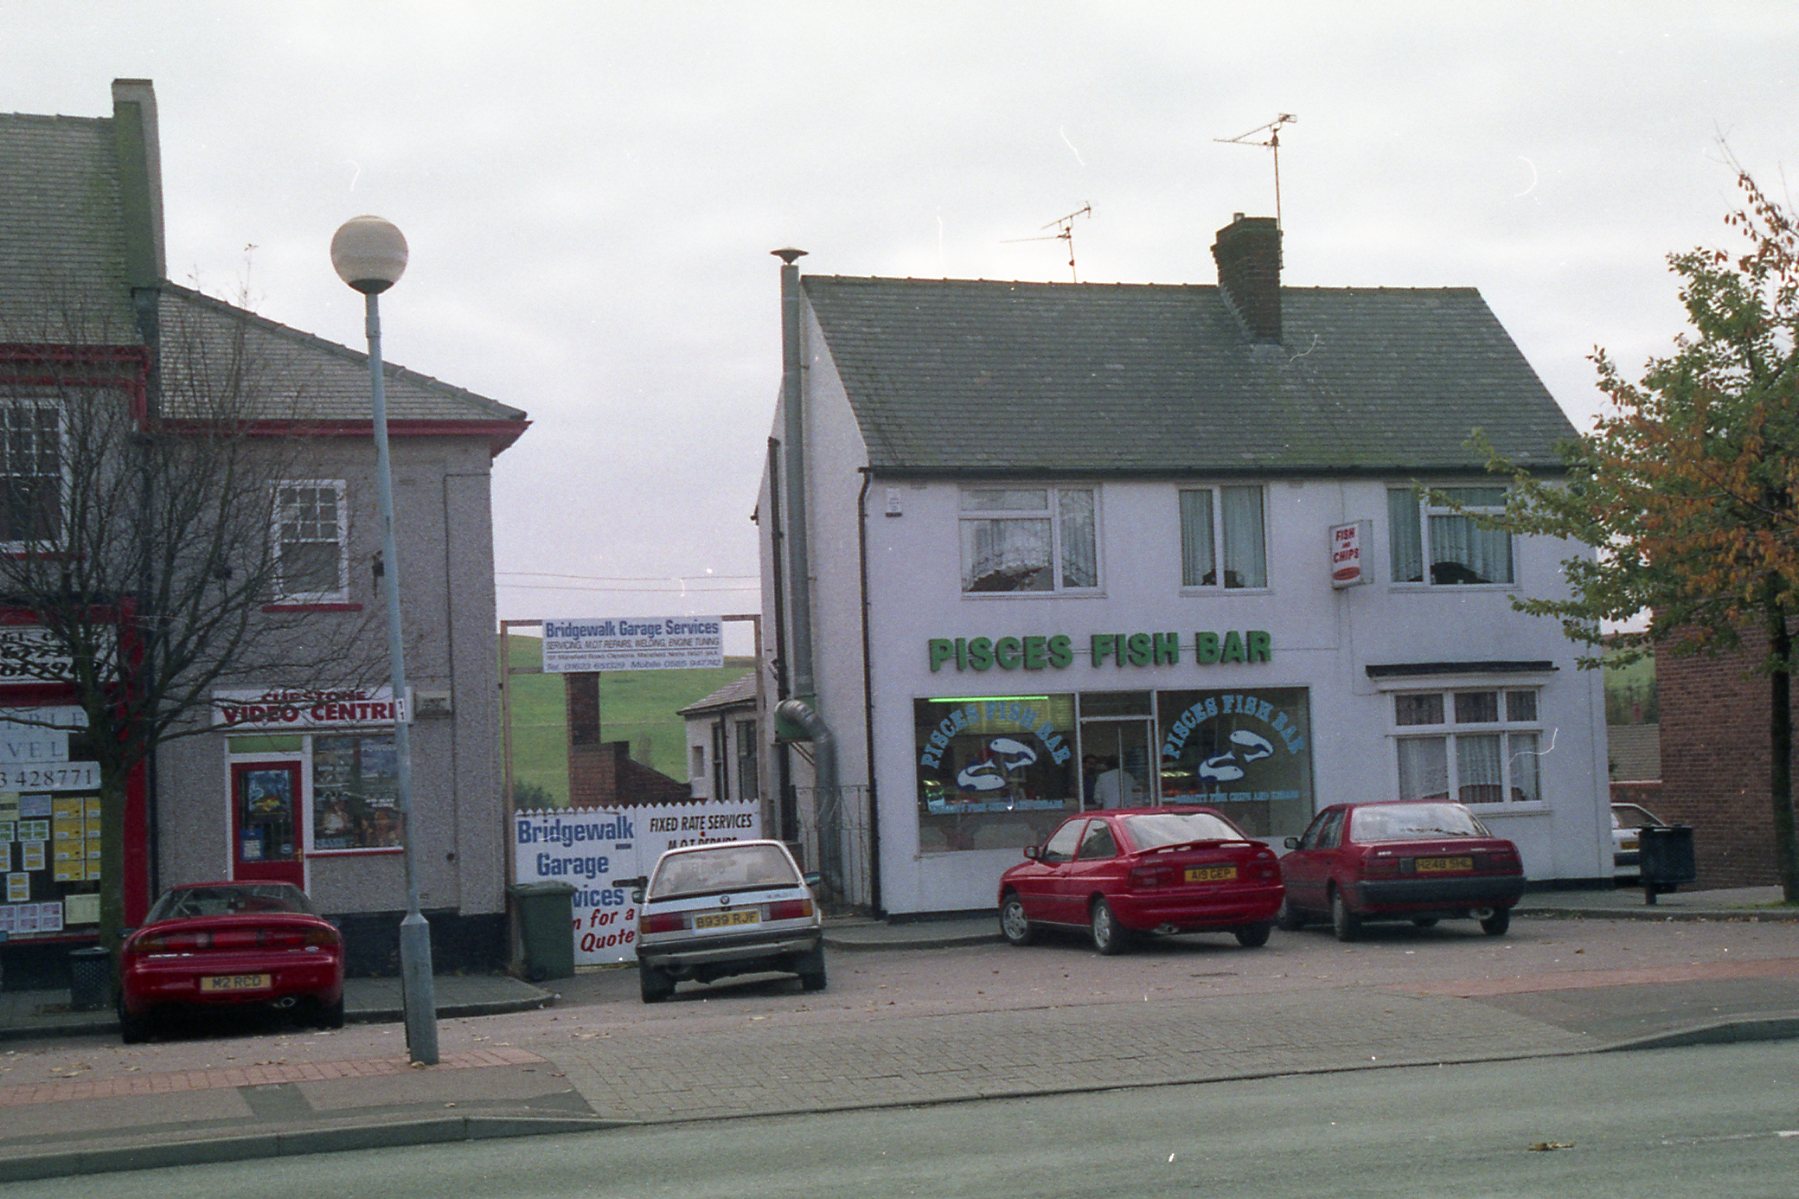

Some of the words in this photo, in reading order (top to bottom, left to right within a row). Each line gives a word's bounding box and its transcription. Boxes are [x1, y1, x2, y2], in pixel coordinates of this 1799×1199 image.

[1335, 528, 1355, 541] FISH
[1333, 547, 1359, 563] CHIPS
[546, 620, 616, 640] Bridgewalk
[619, 620, 662, 638] Garage
[665, 618, 719, 635] Services
[668, 638, 693, 647] ENGINE
[695, 637, 720, 646] TUNING
[928, 634, 1073, 673] PISCES
[1090, 632, 1179, 669] FISH
[1195, 630, 1272, 665] BAR
[222, 705, 300, 724] VIDEO
[920, 703, 980, 769] PISCES
[985, 701, 1038, 730] FISH
[1035, 720, 1072, 765] BAR
[1162, 697, 1219, 760] PISCES
[1222, 695, 1274, 722] FISH
[1272, 711, 1305, 754] BAR
[15, 769, 91, 787] 428771
[518, 816, 634, 847] Bridgewalk
[650, 817, 678, 832] FIXED
[681, 815, 705, 831] RATE
[708, 813, 752, 829] SERVICES
[536, 852, 609, 879] Garage
[590, 908, 618, 928] for
[625, 908, 635, 921] a
[696, 914, 730, 928] B939
[581, 928, 636, 952] Quote
[213, 976, 230, 988] M2
[234, 976, 261, 987] RCD
